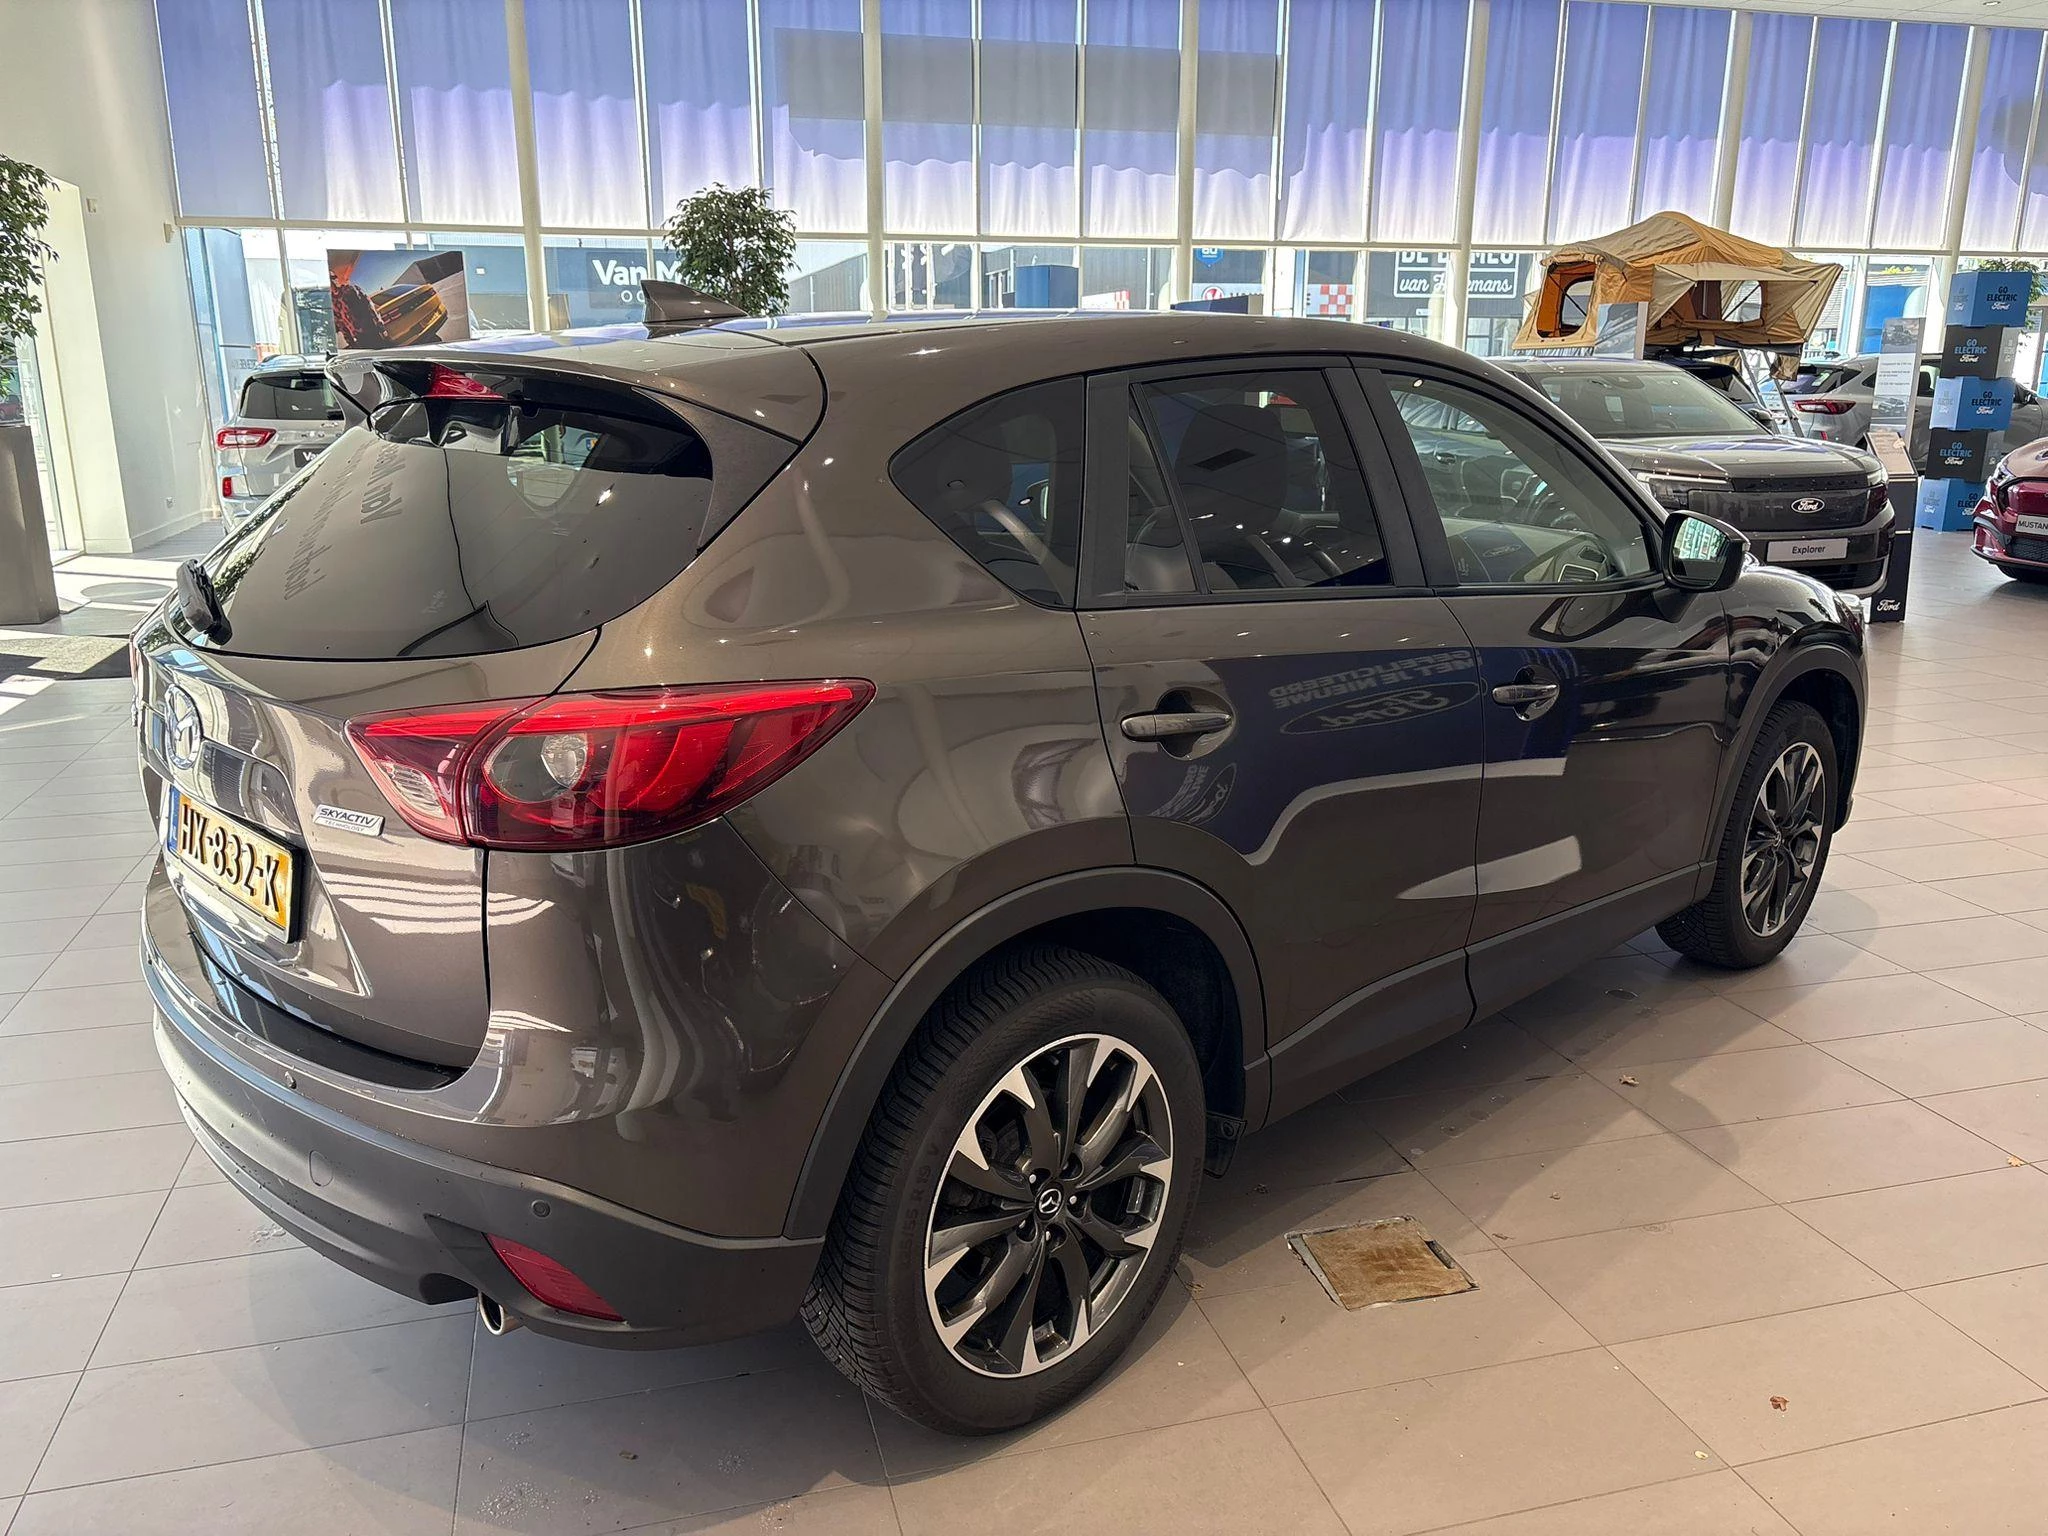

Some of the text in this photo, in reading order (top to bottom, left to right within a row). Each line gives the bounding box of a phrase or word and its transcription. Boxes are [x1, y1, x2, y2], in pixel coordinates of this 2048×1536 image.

[592, 259, 647, 286] Van
[1399, 278, 1430, 292] van
[1998, 286, 2009, 294] GO
[1986, 293, 2018, 302] ELECTRIC
[1991, 301, 2011, 310] Ford
[1966, 338, 1978, 347] GO
[1954, 346, 1988, 354] ELECTRIC
[1959, 354, 1980, 363] Ford
[1982, 391, 1993, 399] GO
[1971, 398, 2003, 406] ELECTRIC
[1976, 406, 1995, 415] Ford
[1951, 442, 1962, 450] GO
[1939, 449, 1973, 457] ELECTRIC
[1944, 456, 1965, 465] Ford
[1968, 492, 1978, 500] GO
[1791, 545, 1826, 555] Explorer
[1876, 599, 1901, 612] Ford
[320, 808, 375, 825] SKYACTIV
[325, 820, 365, 832] TECHNOLOGY
[181, 803, 281, 912] HX-832-K
